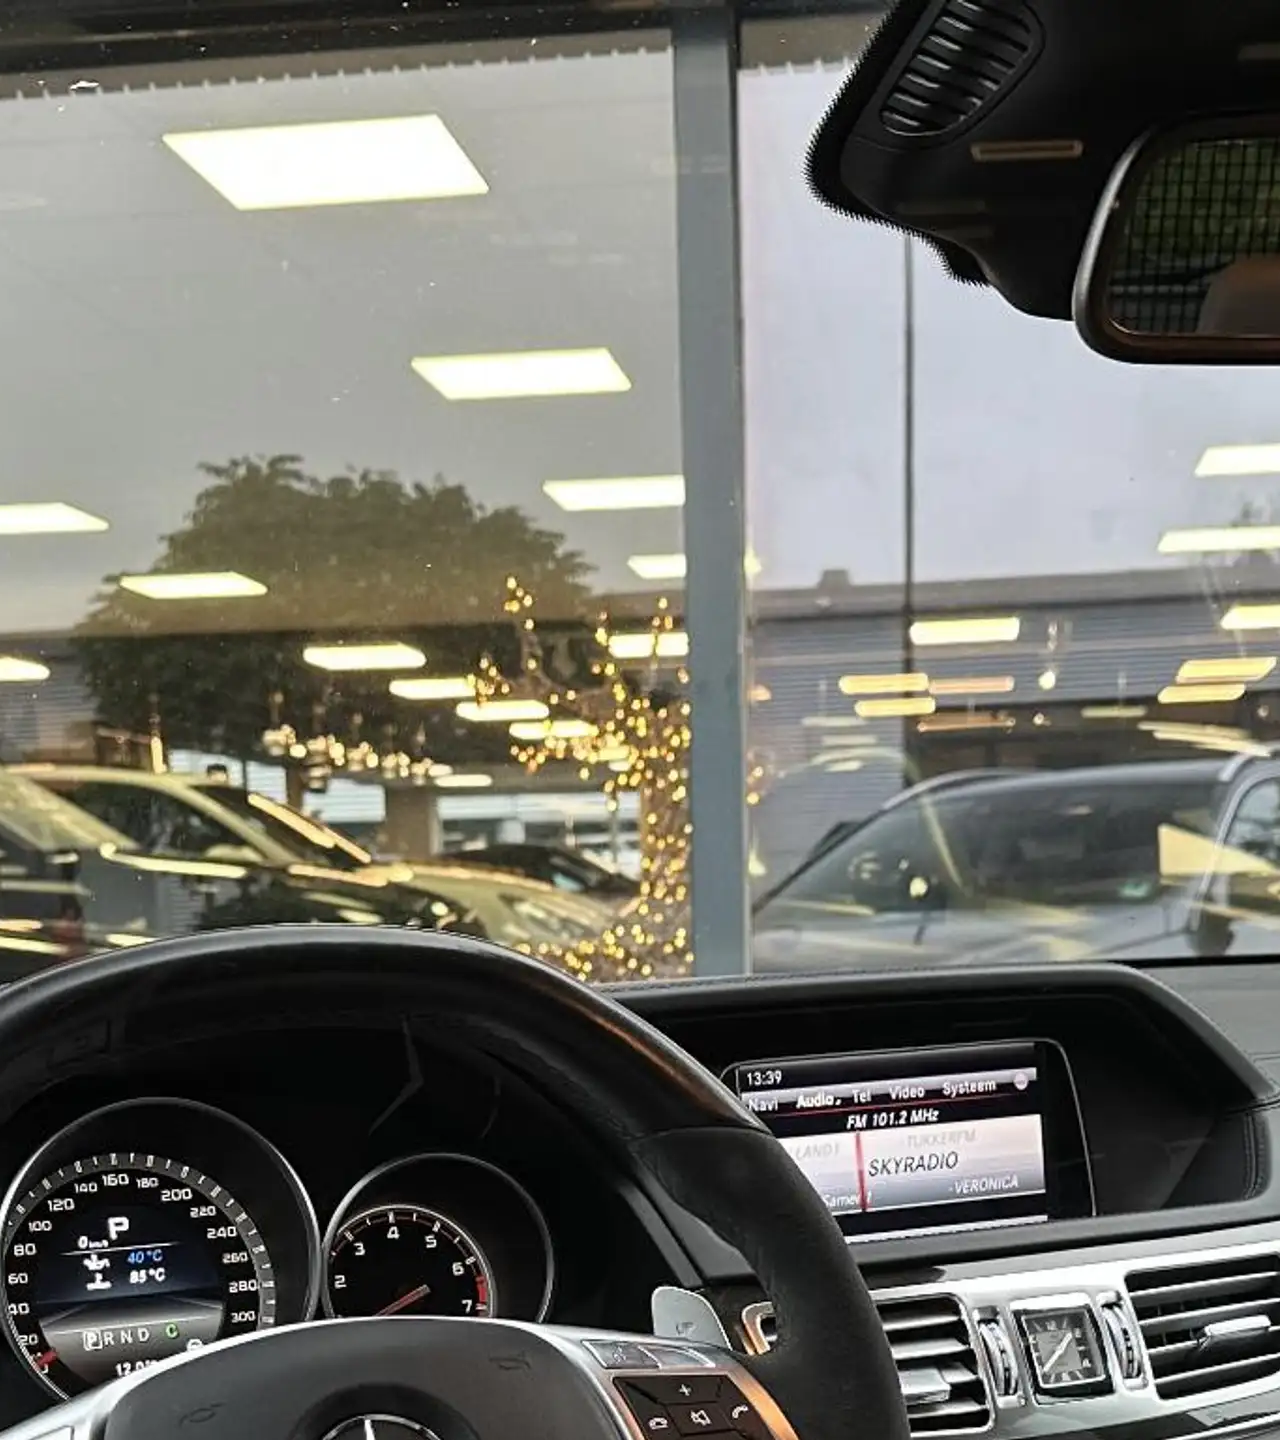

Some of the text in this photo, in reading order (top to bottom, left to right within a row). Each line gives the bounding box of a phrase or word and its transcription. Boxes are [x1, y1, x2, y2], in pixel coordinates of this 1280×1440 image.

[746, 1070, 782, 1086] 13:39
[748, 1097, 779, 1112] Navi
[796, 1091, 834, 1109] Audio
[852, 1089, 872, 1103] Tel
[889, 1085, 926, 1100] Video
[942, 1079, 997, 1098] Systeem
[846, 1108, 939, 1129] FM 101.2 MHz
[868, 1150, 959, 1177] SKYRADIO
[102, 1173, 129, 1187] 160
[136, 1177, 159, 1189] 180
[74, 1182, 98, 1194] 140
[161, 1188, 193, 1201] 200
[48, 1198, 75, 1212] 120
[190, 1205, 217, 1218] 220
[28, 1220, 52, 1233] 100
[107, 1216, 129, 1240] P
[207, 1226, 237, 1239] 240
[386, 1226, 400, 1239] 4
[77, 1236, 89, 1249] 0
[425, 1235, 437, 1248] 5
[13, 1243, 37, 1256] 80
[353, 1242, 366, 1255] 3
[222, 1252, 248, 1264] 260
[452, 1261, 465, 1276] 6
[8, 1273, 28, 1285] 60
[334, 1275, 347, 1289] 2
[229, 1279, 258, 1293] 280
[8, 1303, 29, 1315] 40
[462, 1299, 473, 1313] 7
[231, 1311, 256, 1323] 300
[19, 1333, 38, 1345] 20
[104, 1332, 115, 1345] R
[120, 1330, 133, 1344] N
[137, 1328, 150, 1342] D
